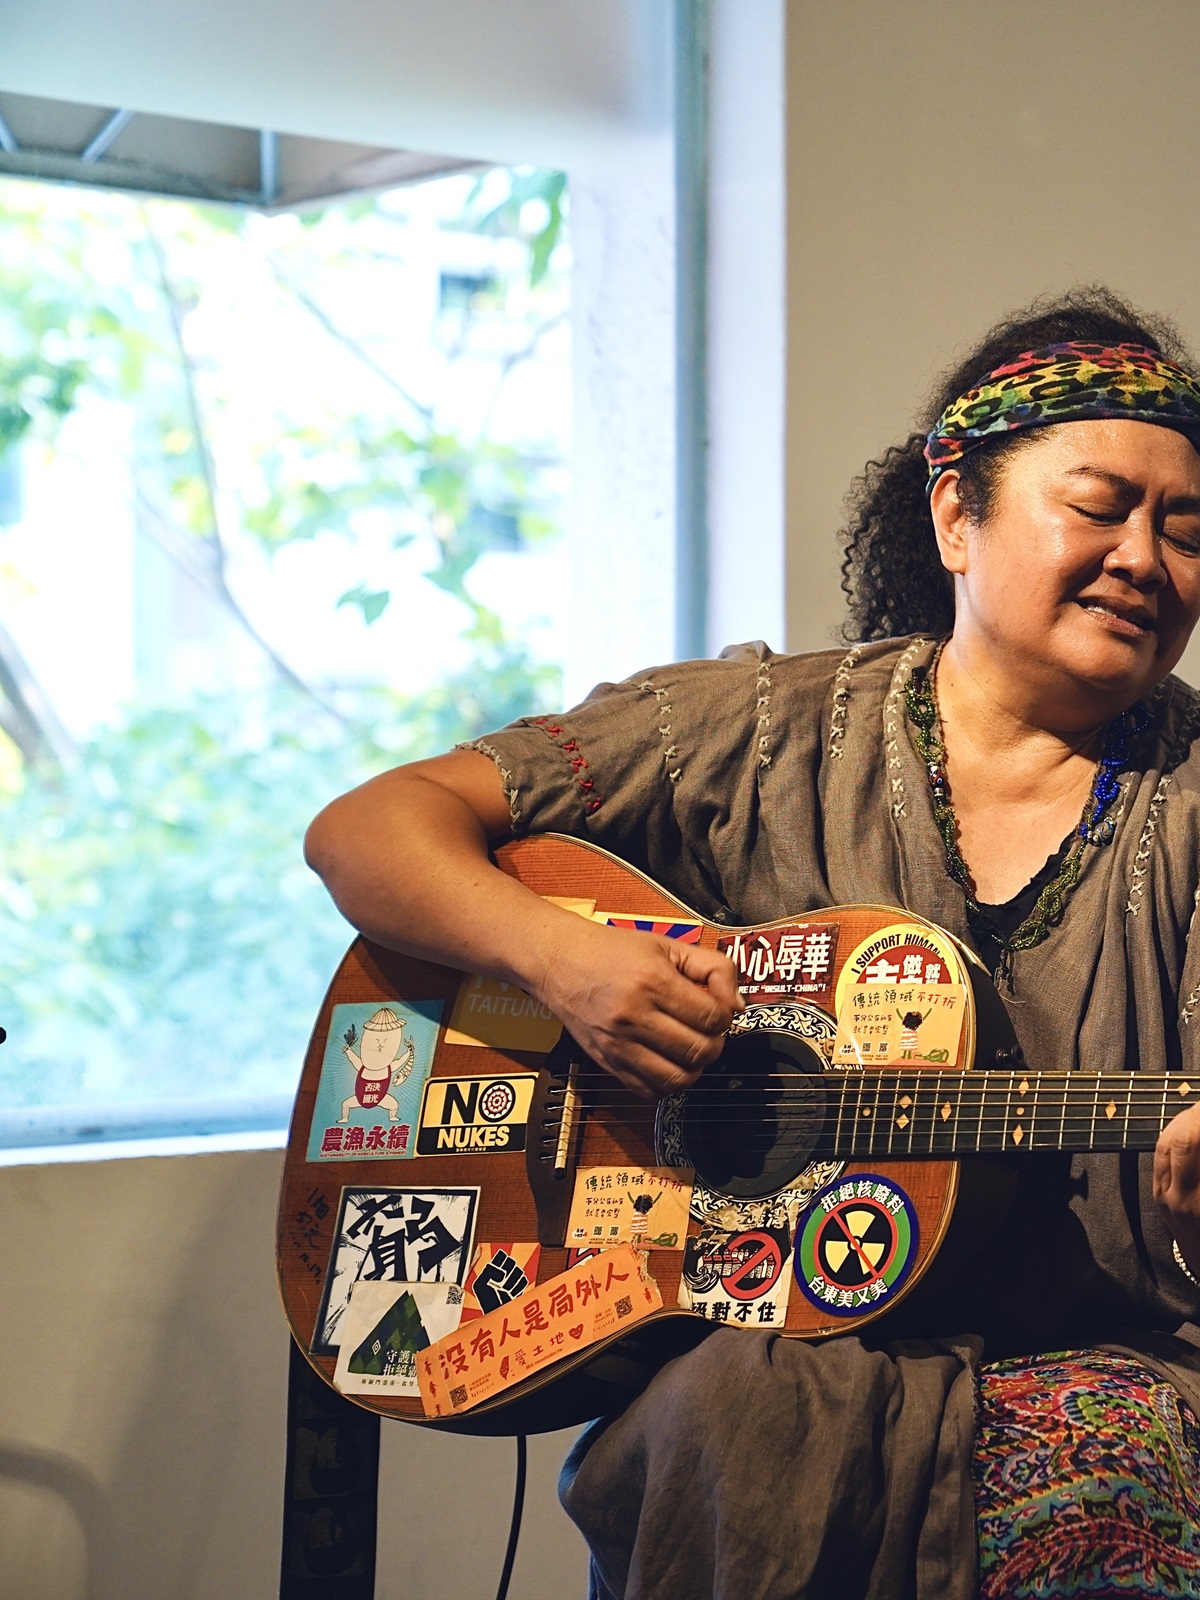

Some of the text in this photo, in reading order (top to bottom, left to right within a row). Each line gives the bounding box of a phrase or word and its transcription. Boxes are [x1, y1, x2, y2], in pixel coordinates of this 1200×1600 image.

[725, 933, 832, 982] 小心辱華
[855, 934, 902, 969] SUPPORT
[851, 967, 861, 975] I
[469, 993, 553, 1020] TAITUNG
[441, 1081, 516, 1125] NO
[321, 1125, 411, 1152] 農漁永續
[437, 1126, 510, 1149] NUKES
[820, 1180, 905, 1216] 拒絕核廢料
[808, 1275, 888, 1308] 台東美又美
